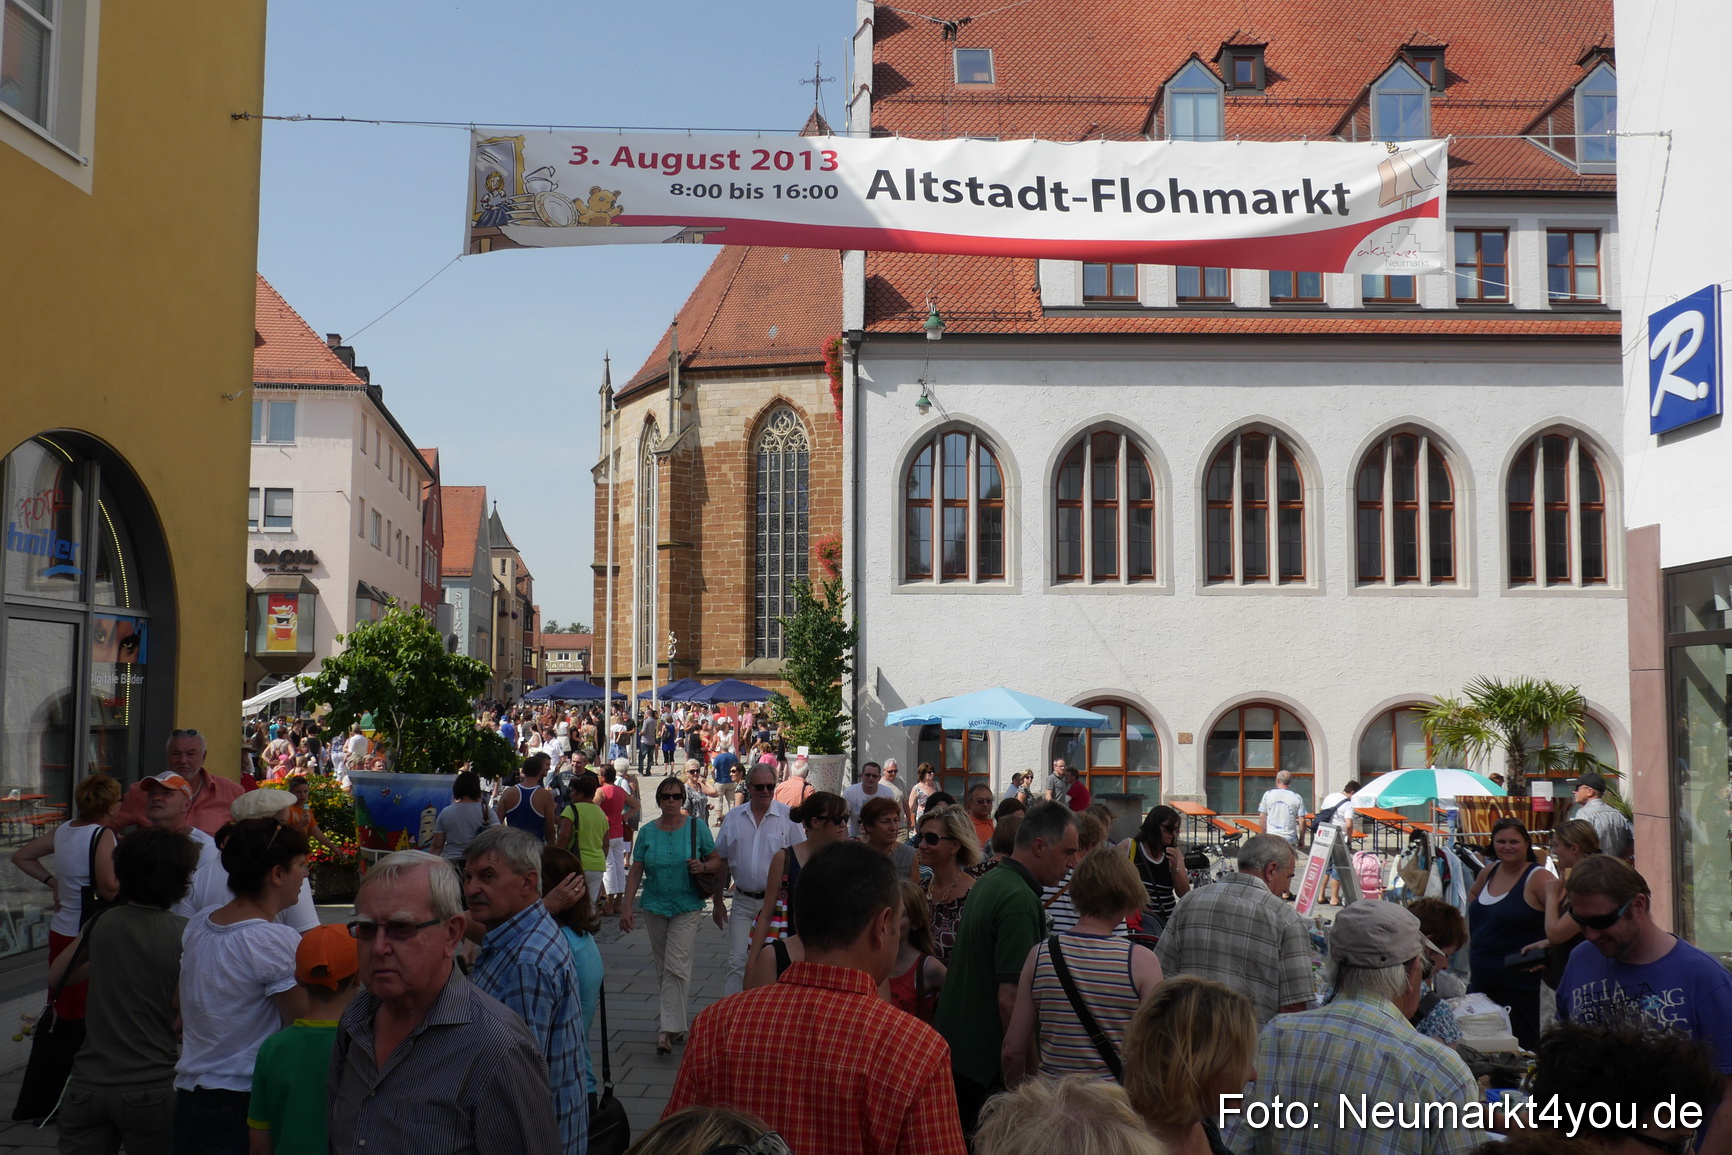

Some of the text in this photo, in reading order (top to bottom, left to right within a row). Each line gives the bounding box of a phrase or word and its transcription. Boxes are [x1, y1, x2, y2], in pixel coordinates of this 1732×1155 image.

[568, 145, 839, 176] 3. August 2013
[669, 182, 839, 200] 8:00 bis 16:00
[866, 168, 1351, 216] Altstadt-Flohmarkt
[1357, 239, 1418, 259] aktives
[1385, 258, 1430, 268] Neumarkt
